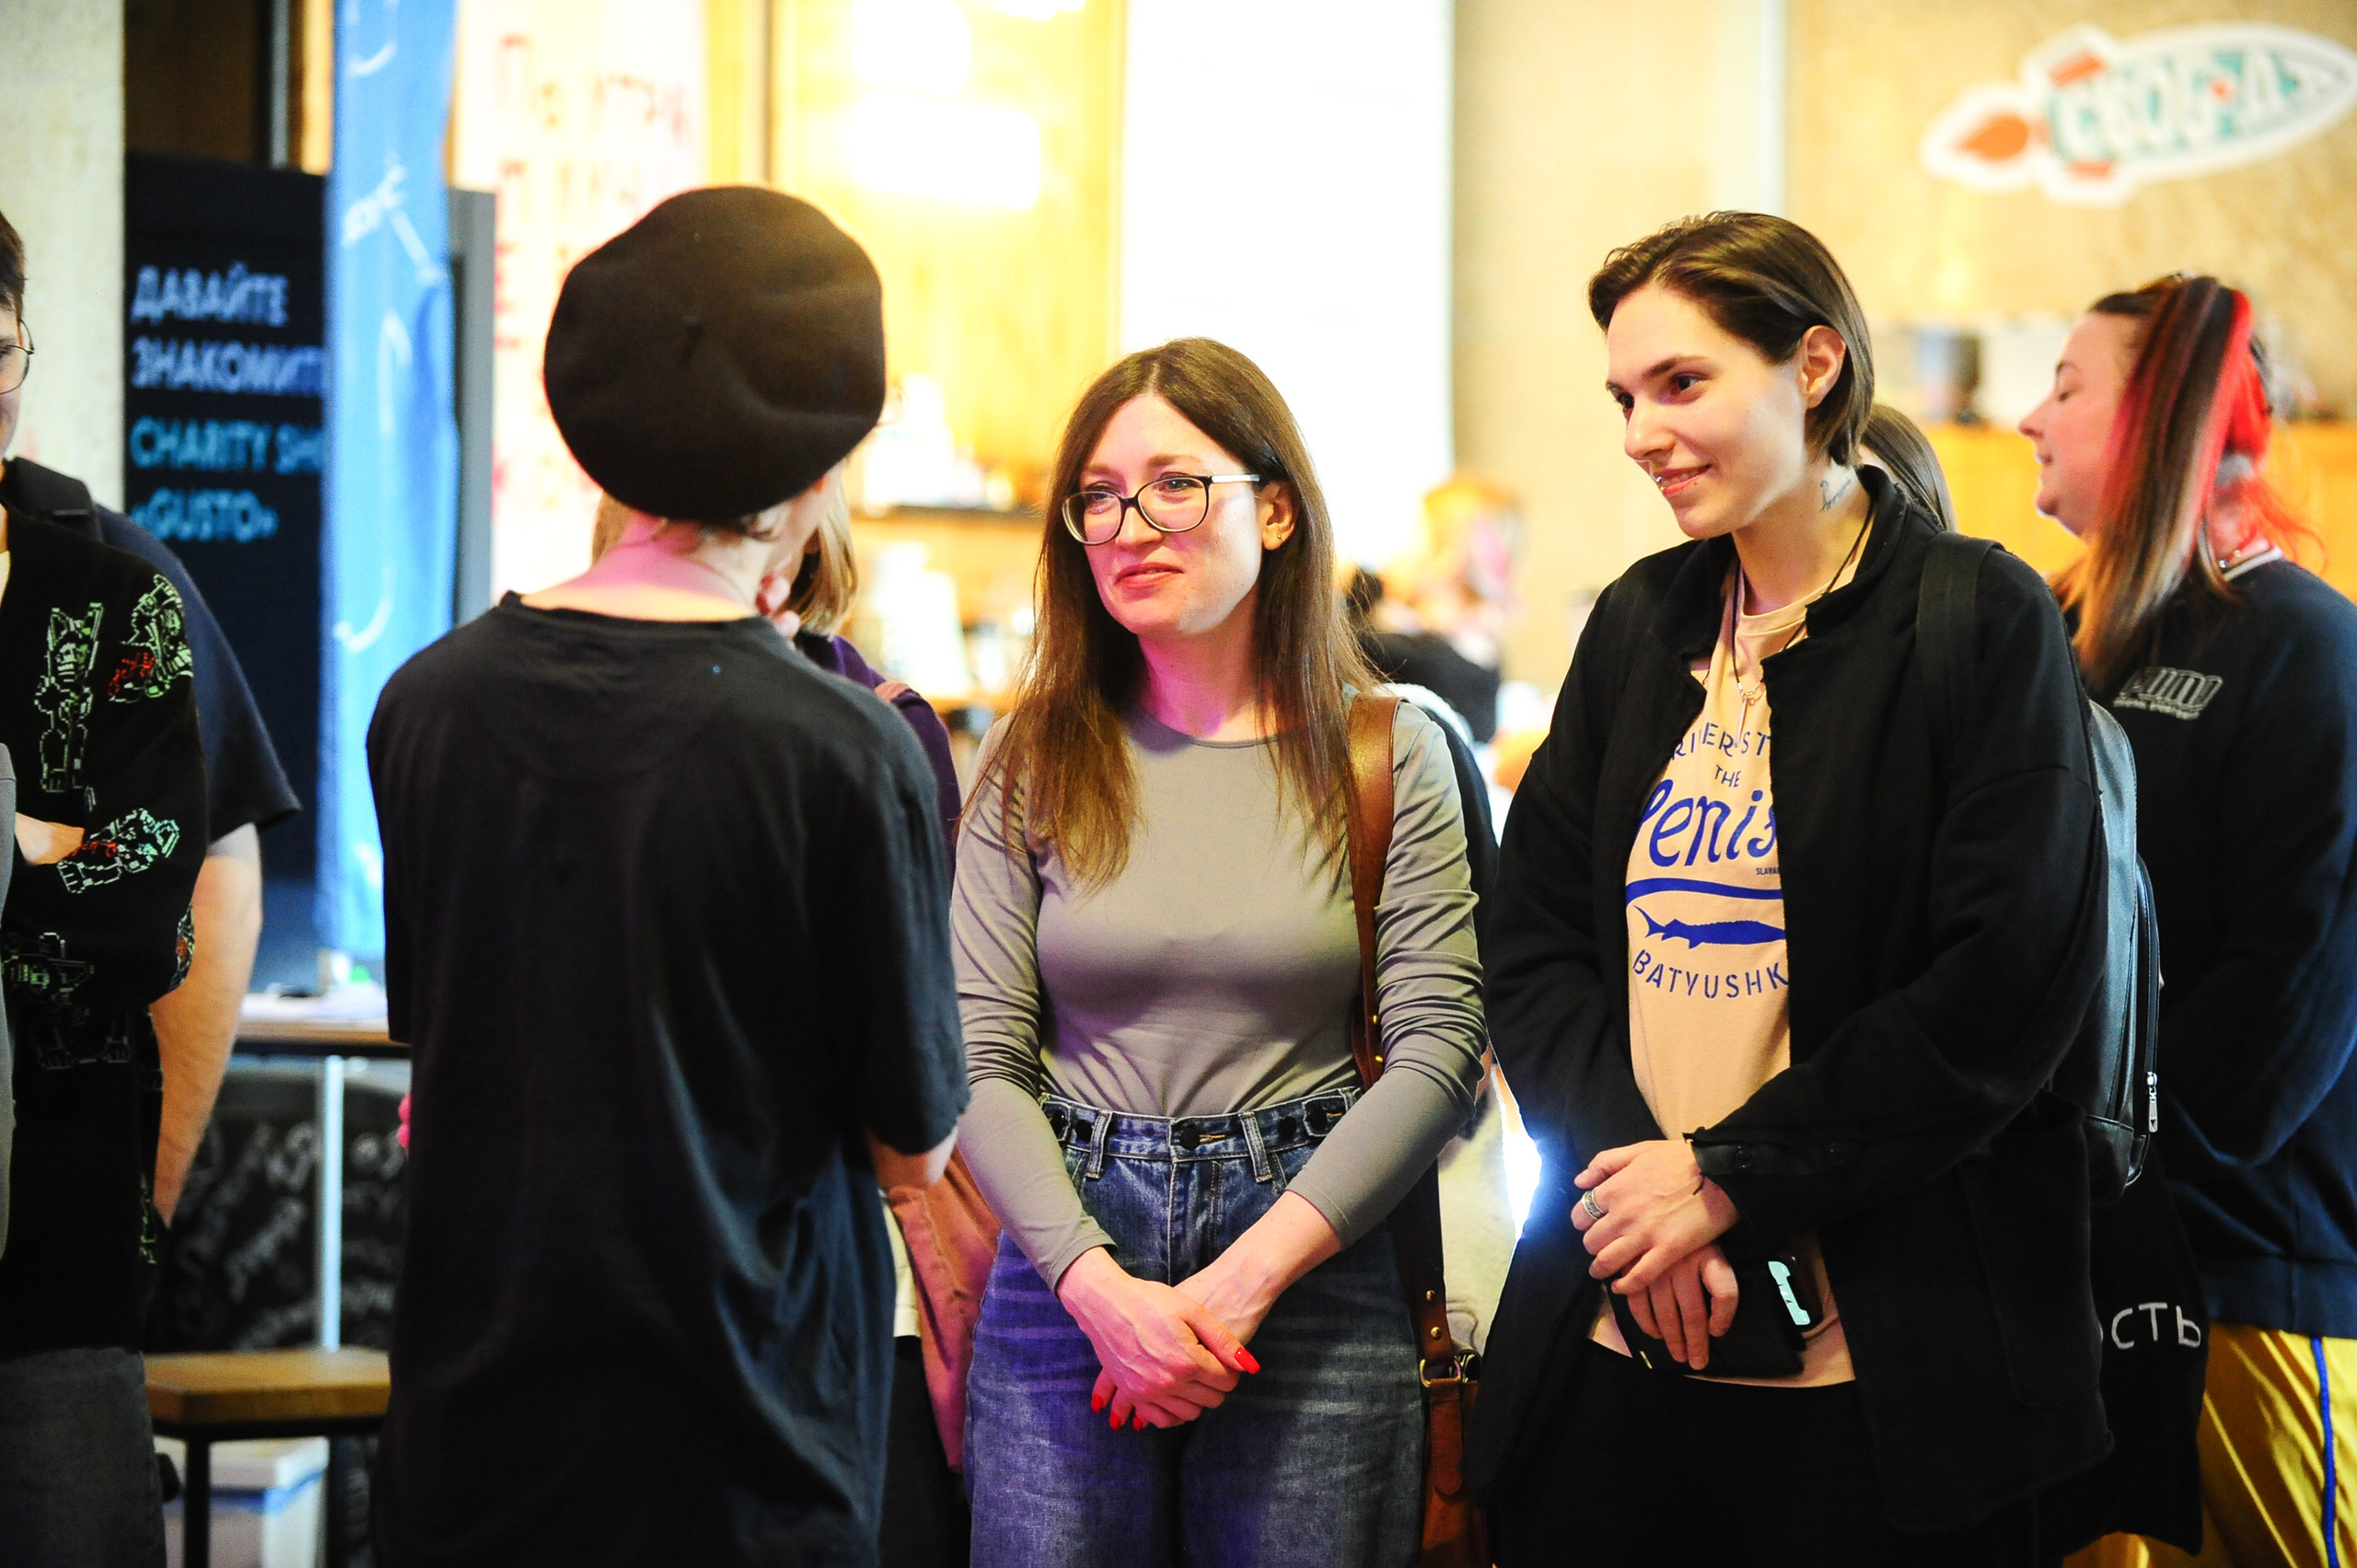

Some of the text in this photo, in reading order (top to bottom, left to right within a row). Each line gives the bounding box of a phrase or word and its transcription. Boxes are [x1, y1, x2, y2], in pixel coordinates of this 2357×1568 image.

[131, 261, 289, 327] ДАВАЙТЕ
[130, 417, 271, 473] CHARITY
[1714, 764, 1742, 788] THE
[1632, 948, 1789, 999] BATYUSHK
[2098, 1302, 2201, 1350] СТЬ
